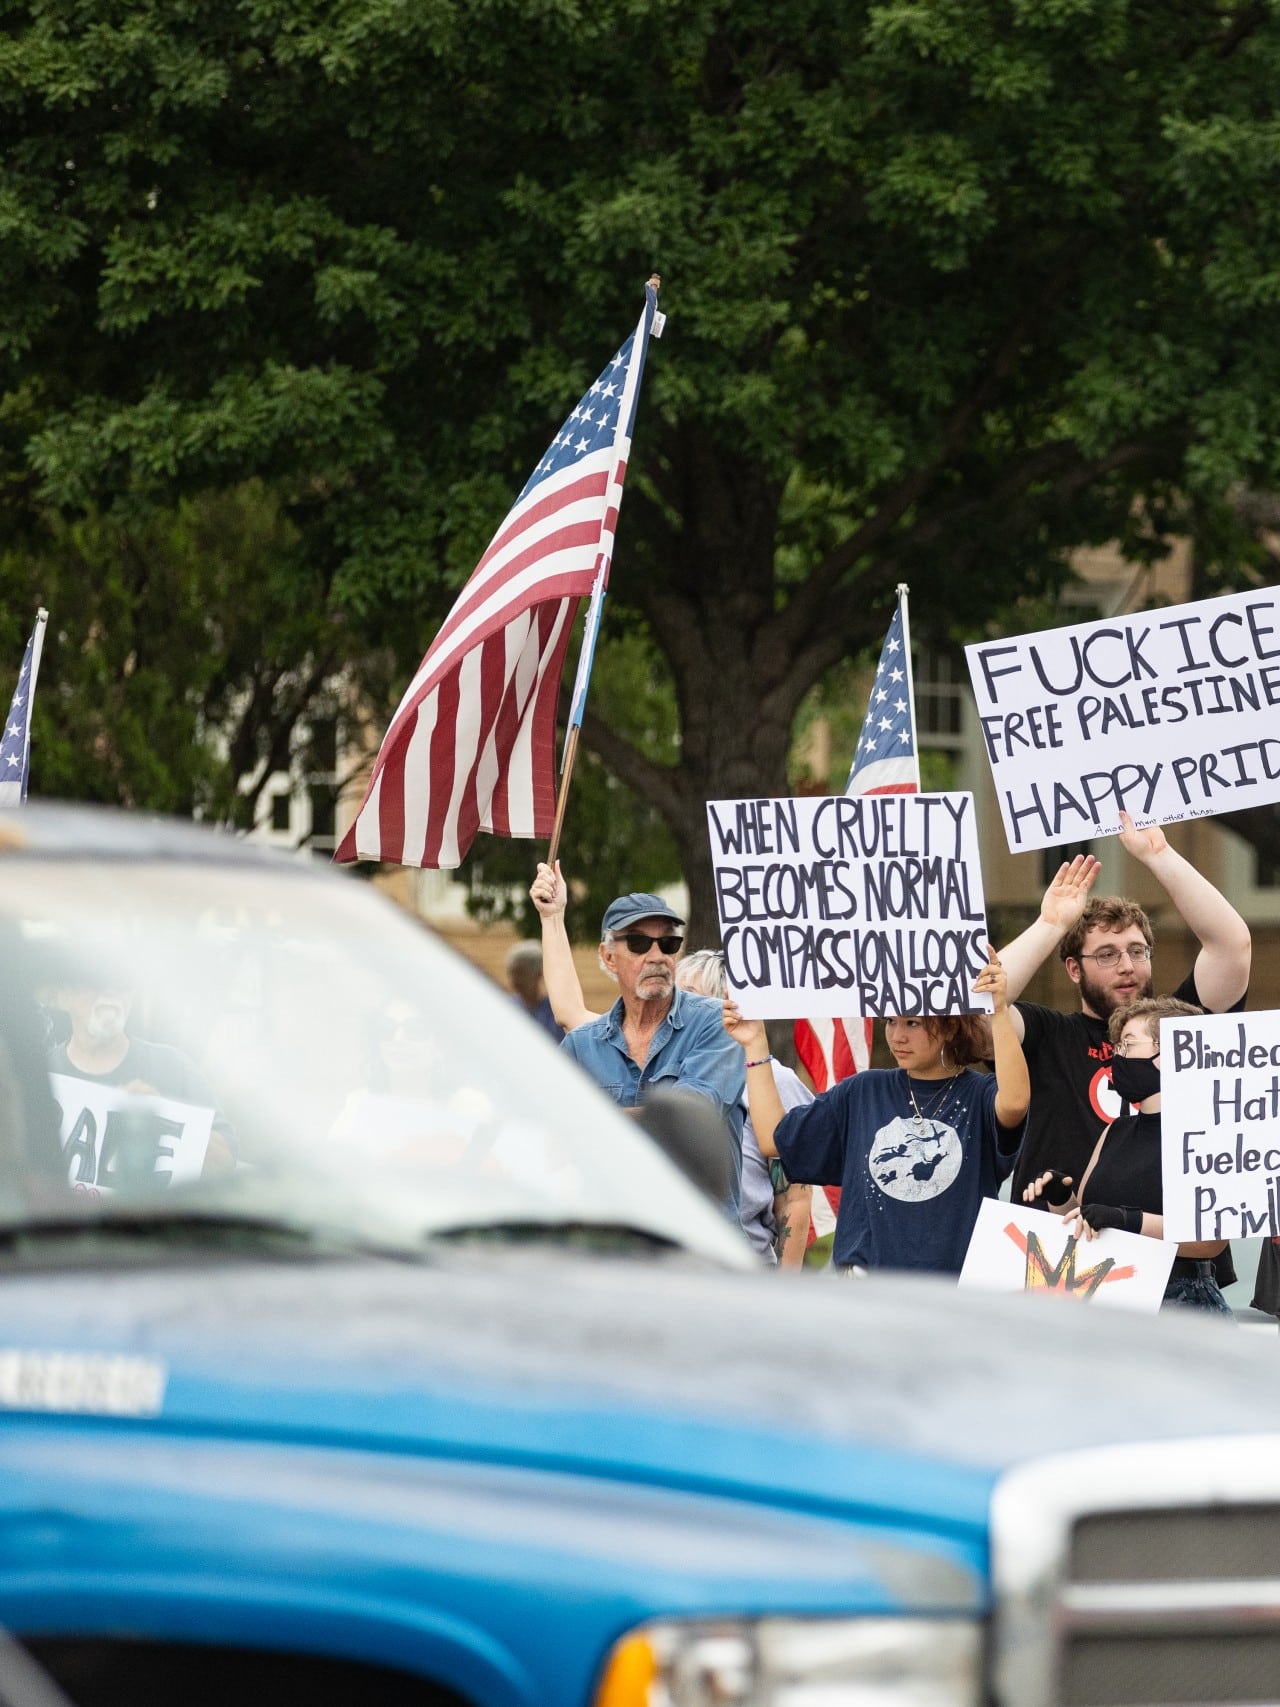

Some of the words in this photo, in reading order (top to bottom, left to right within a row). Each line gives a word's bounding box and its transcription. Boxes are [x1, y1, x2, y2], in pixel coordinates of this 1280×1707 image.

[977, 626, 1158, 704] FUCK
[980, 703, 1063, 764] FREE
[708, 800, 800, 855] WHEN
[812, 796, 969, 863] CRUELTY
[1006, 762, 1163, 844] HAPPY
[1094, 825, 1124, 837] Amon
[1163, 812, 1184, 822] other
[716, 859, 857, 924] BECOMES
[863, 856, 984, 922] NORMAL
[722, 924, 905, 989] COMPASSION
[908, 928, 990, 979] LOOKS
